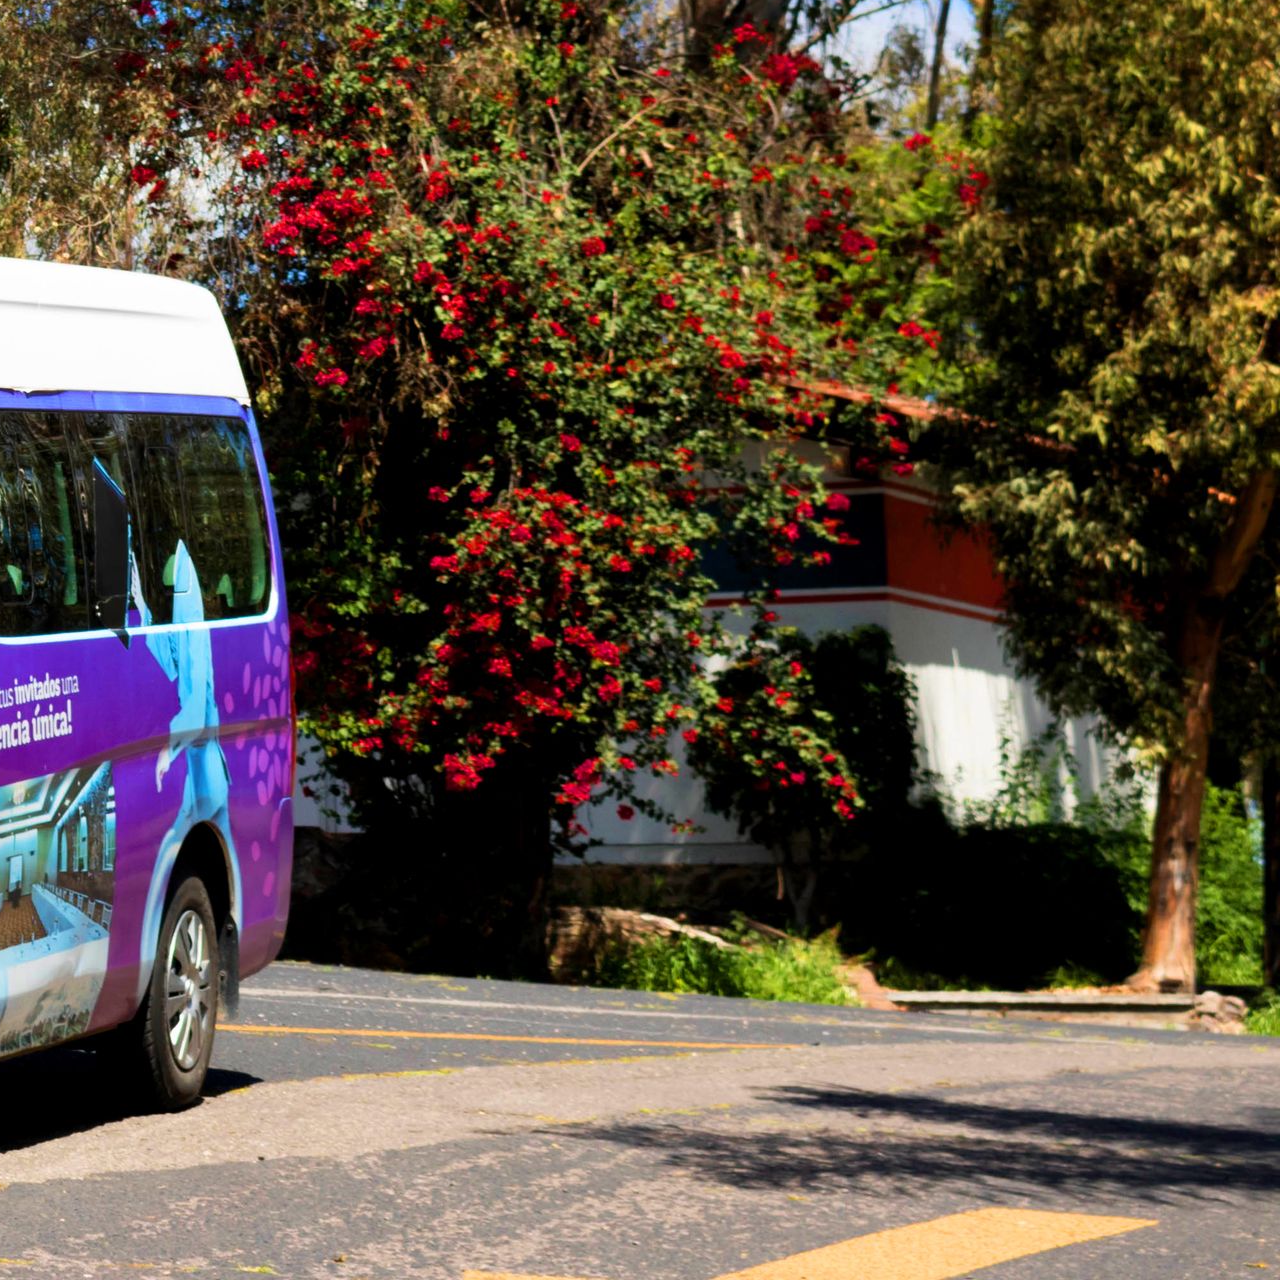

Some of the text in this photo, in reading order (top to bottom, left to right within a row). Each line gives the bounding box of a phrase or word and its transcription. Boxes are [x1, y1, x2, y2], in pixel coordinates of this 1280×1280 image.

[14, 672, 61, 704] invitados
[61, 675, 79, 695] una
[32, 699, 72, 741] única!
